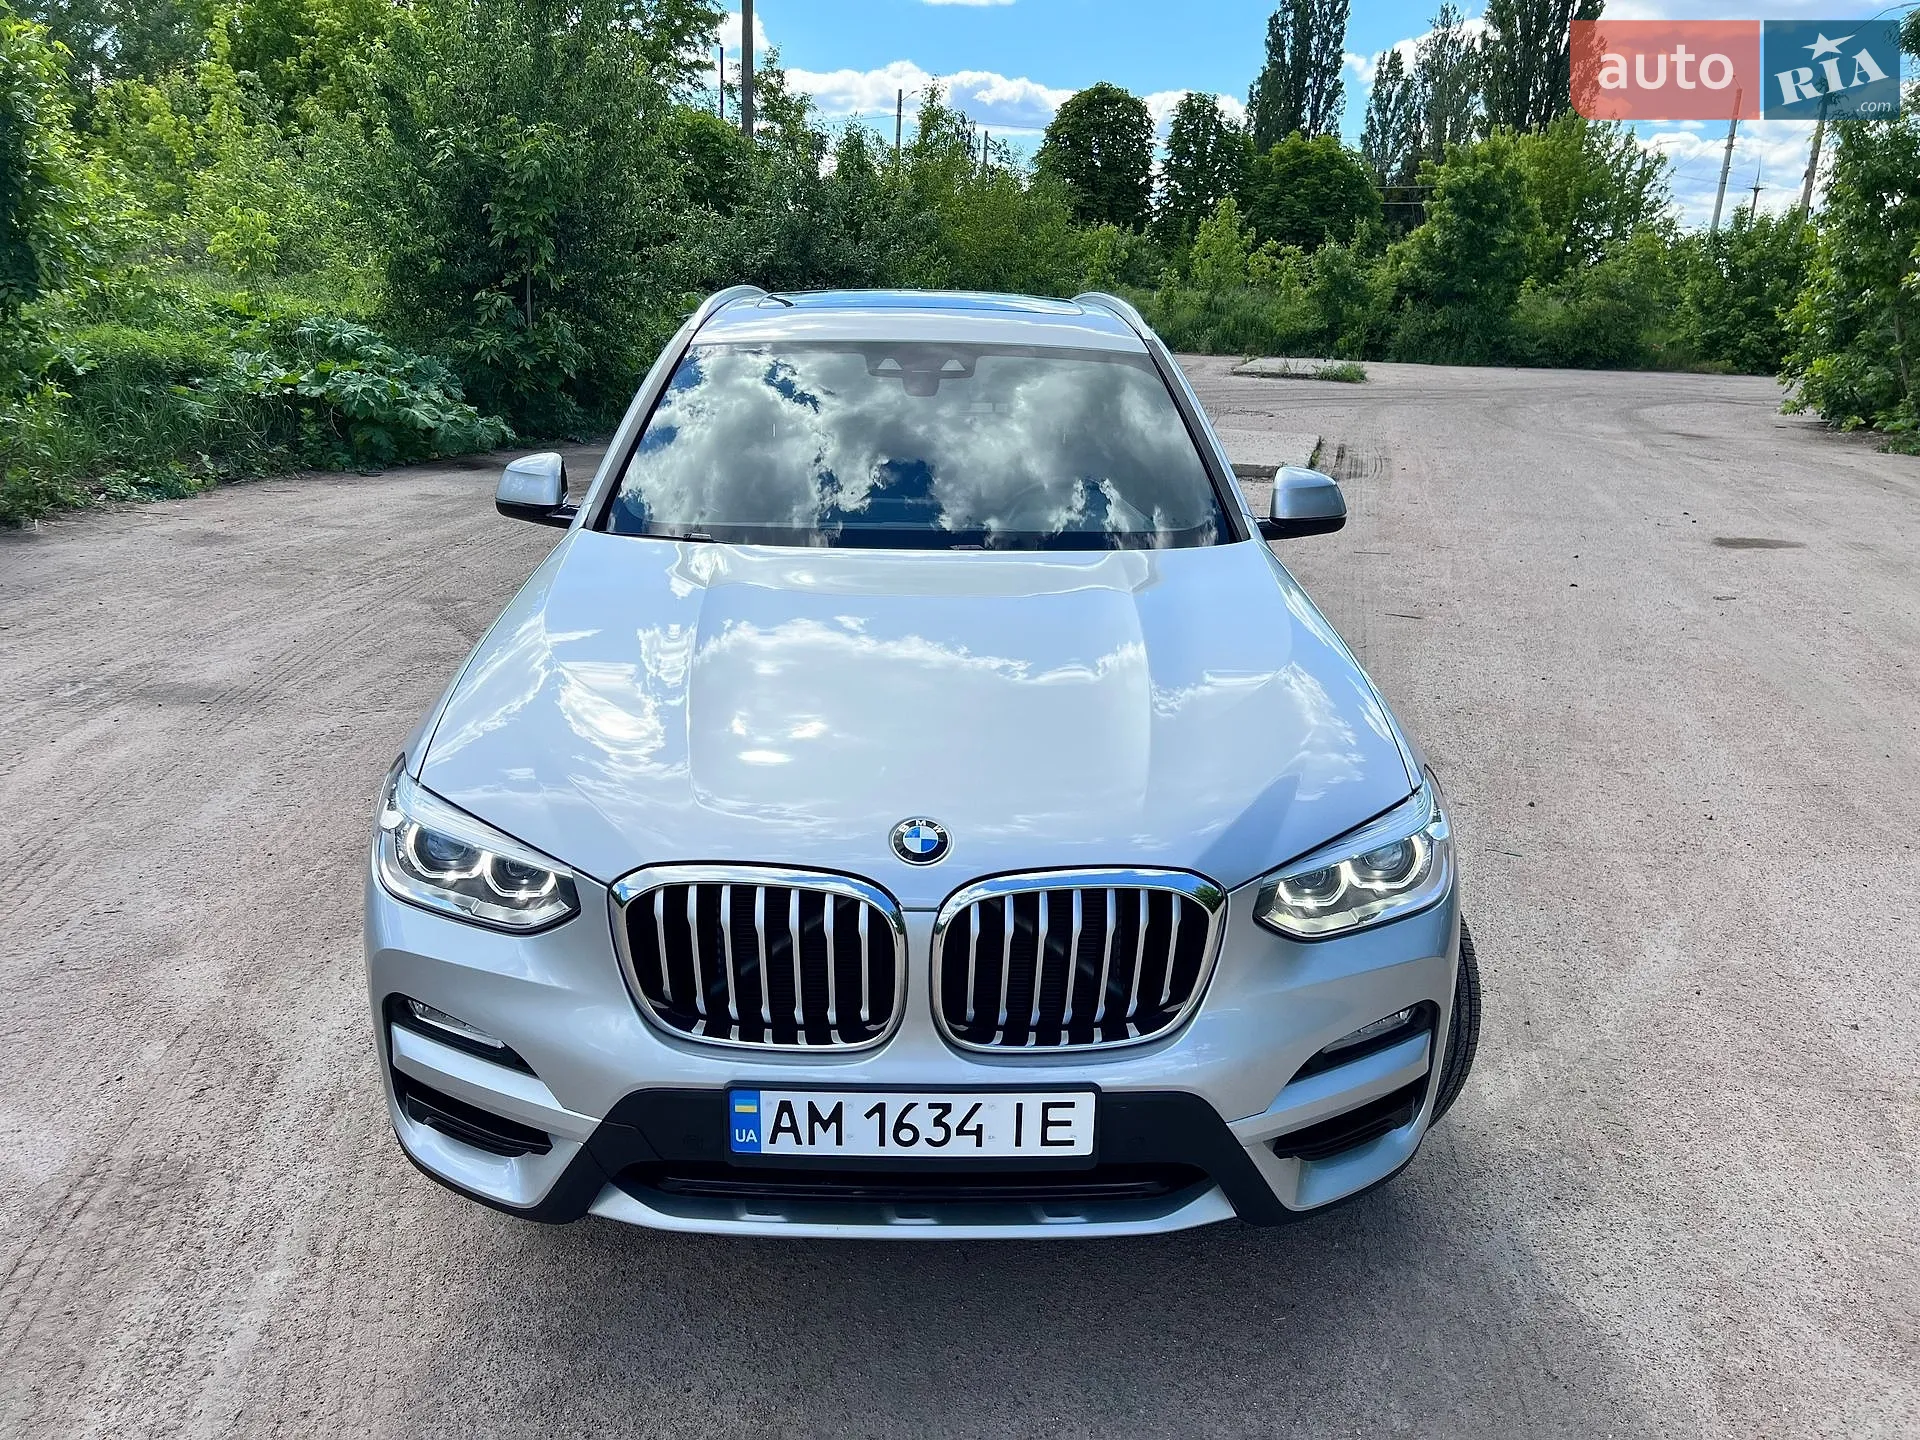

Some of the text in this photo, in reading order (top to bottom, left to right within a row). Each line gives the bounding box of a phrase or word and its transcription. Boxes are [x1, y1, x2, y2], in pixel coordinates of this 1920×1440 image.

[899, 819, 944, 833] BMW
[768, 1099, 1076, 1149] AM 1634 IE
[735, 1129, 758, 1144] UA
